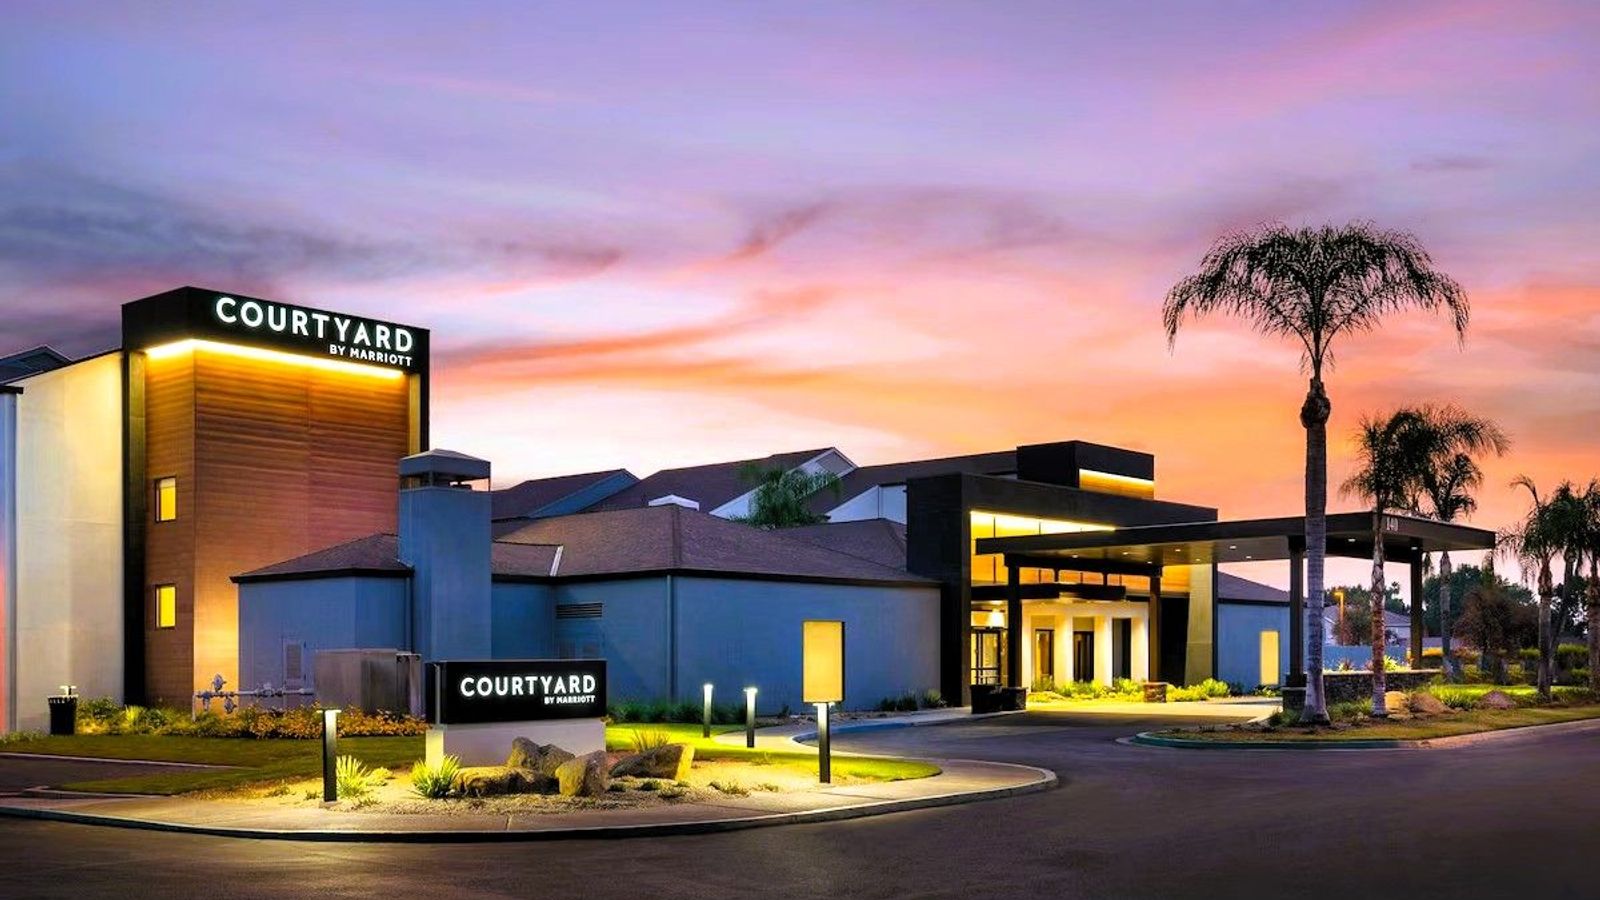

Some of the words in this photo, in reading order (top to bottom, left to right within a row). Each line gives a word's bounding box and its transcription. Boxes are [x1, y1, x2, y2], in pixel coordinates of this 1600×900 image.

[215, 297, 413, 352] COURTYARD
[329, 344, 346, 356] BY
[350, 347, 413, 366] MARRIOTT
[460, 675, 596, 697] COURTYARD
[544, 697, 555, 705] BY
[556, 695, 595, 704] MARRIOTT
